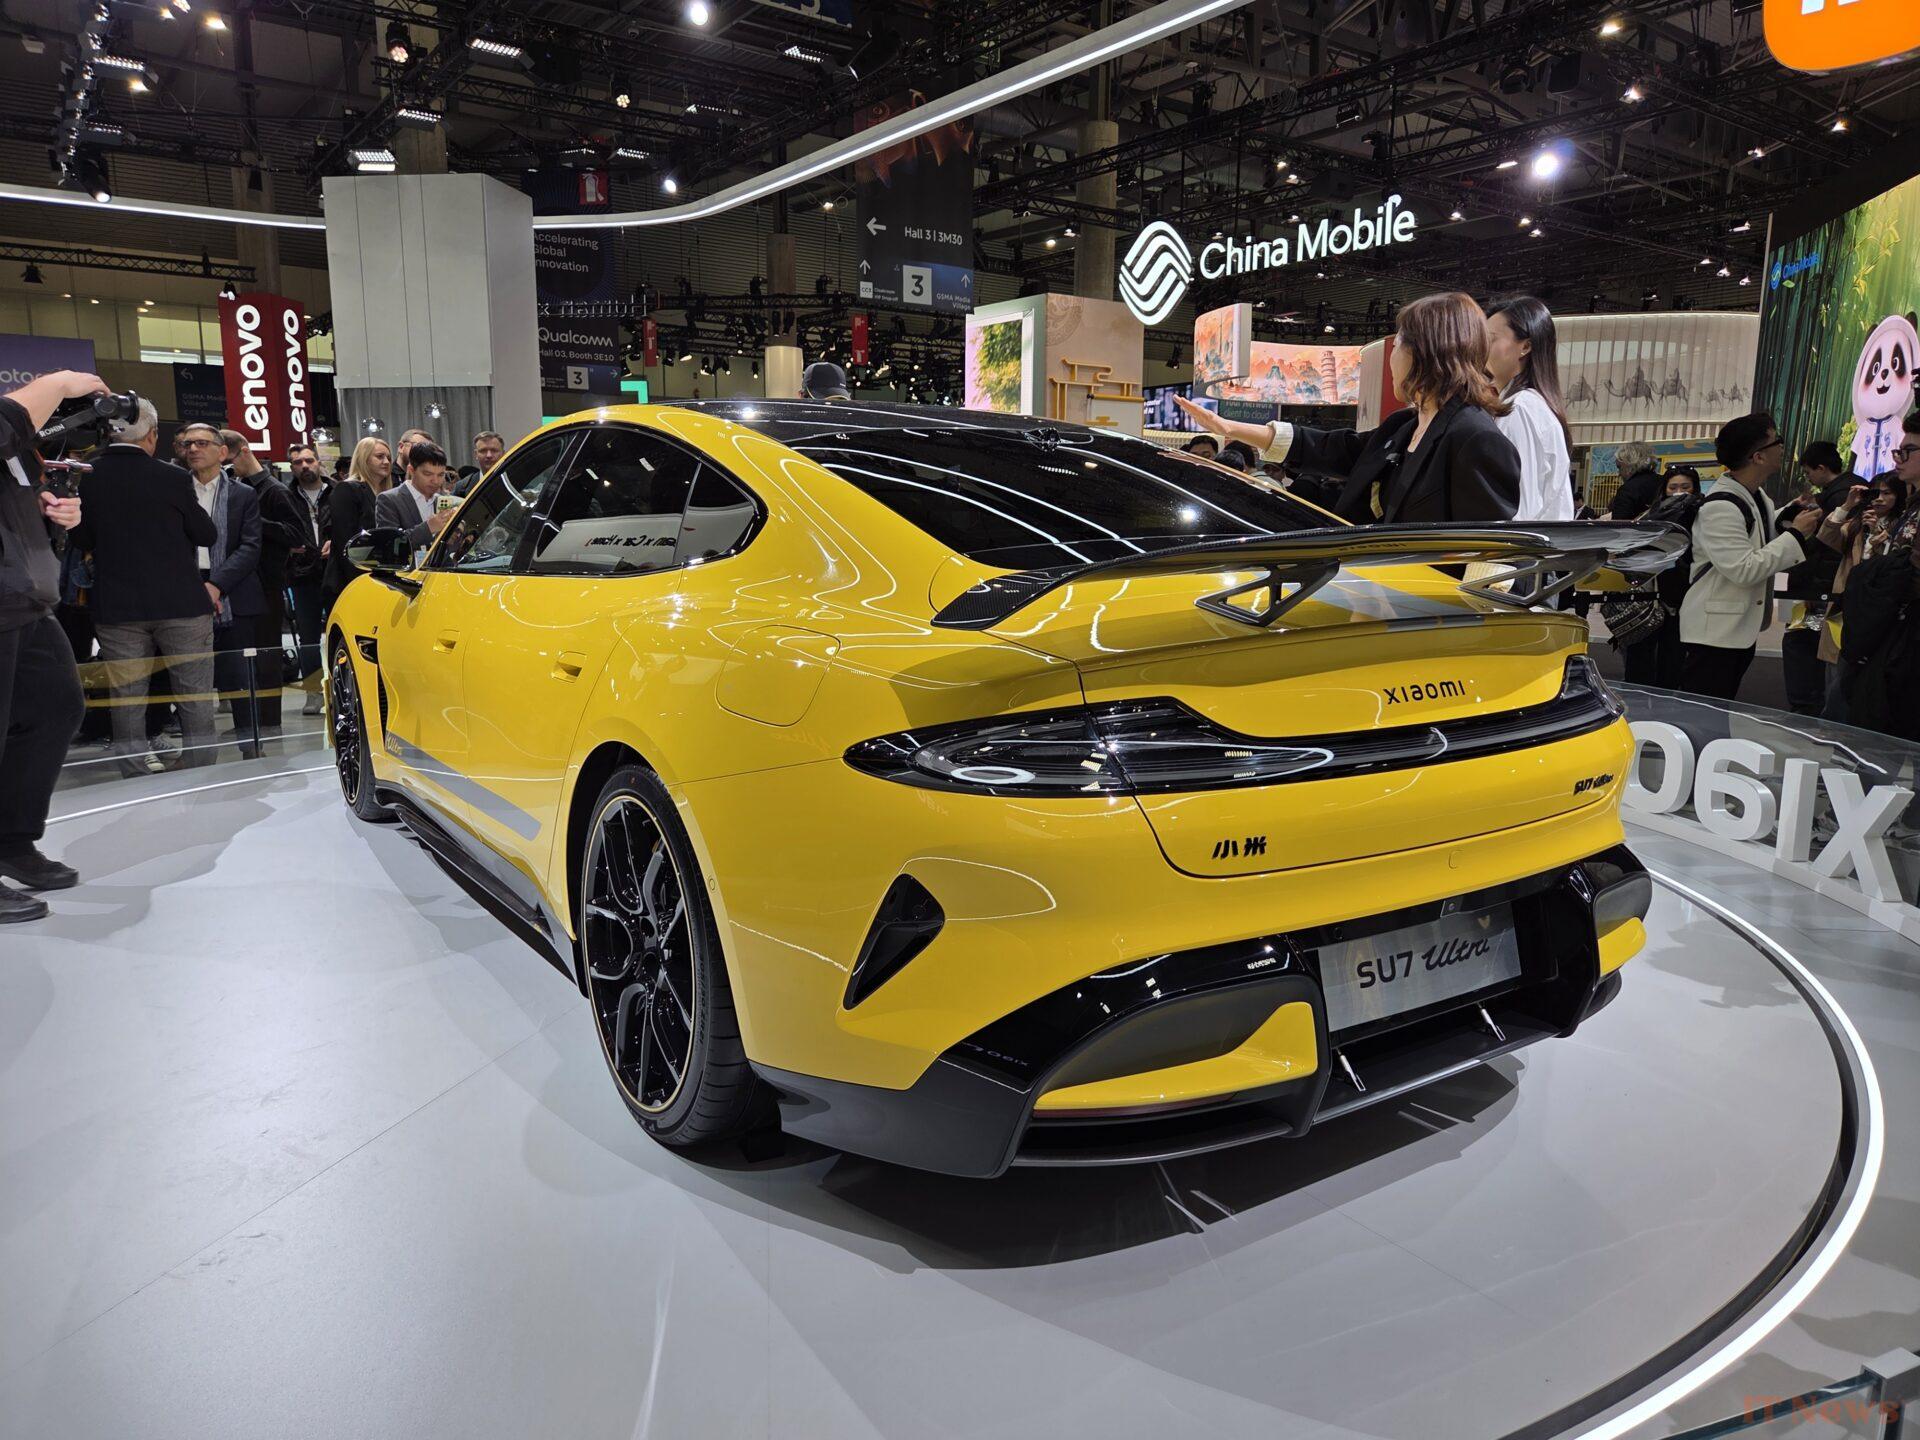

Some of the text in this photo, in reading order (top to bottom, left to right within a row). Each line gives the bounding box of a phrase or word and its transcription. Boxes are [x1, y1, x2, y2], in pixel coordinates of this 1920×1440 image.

[904, 226, 923, 240] Hall
[925, 229, 932, 241] 3
[938, 231, 963, 246] 3M30
[1200, 197, 1416, 279] China Mobile
[535, 258, 589, 272] nnovation
[911, 274, 924, 297] 3
[539, 327, 614, 348] Qualcomm
[569, 350, 592, 360] Booth
[594, 352, 615, 362] 3E10
[236, 304, 272, 451] Lenovo
[573, 371, 583, 385] 3
[39, 423, 65, 438] RONIN
[1383, 680, 1466, 705] xiaomi
[1211, 836, 1266, 860] 小米
[1356, 938, 1490, 989] SU7 Ultra
